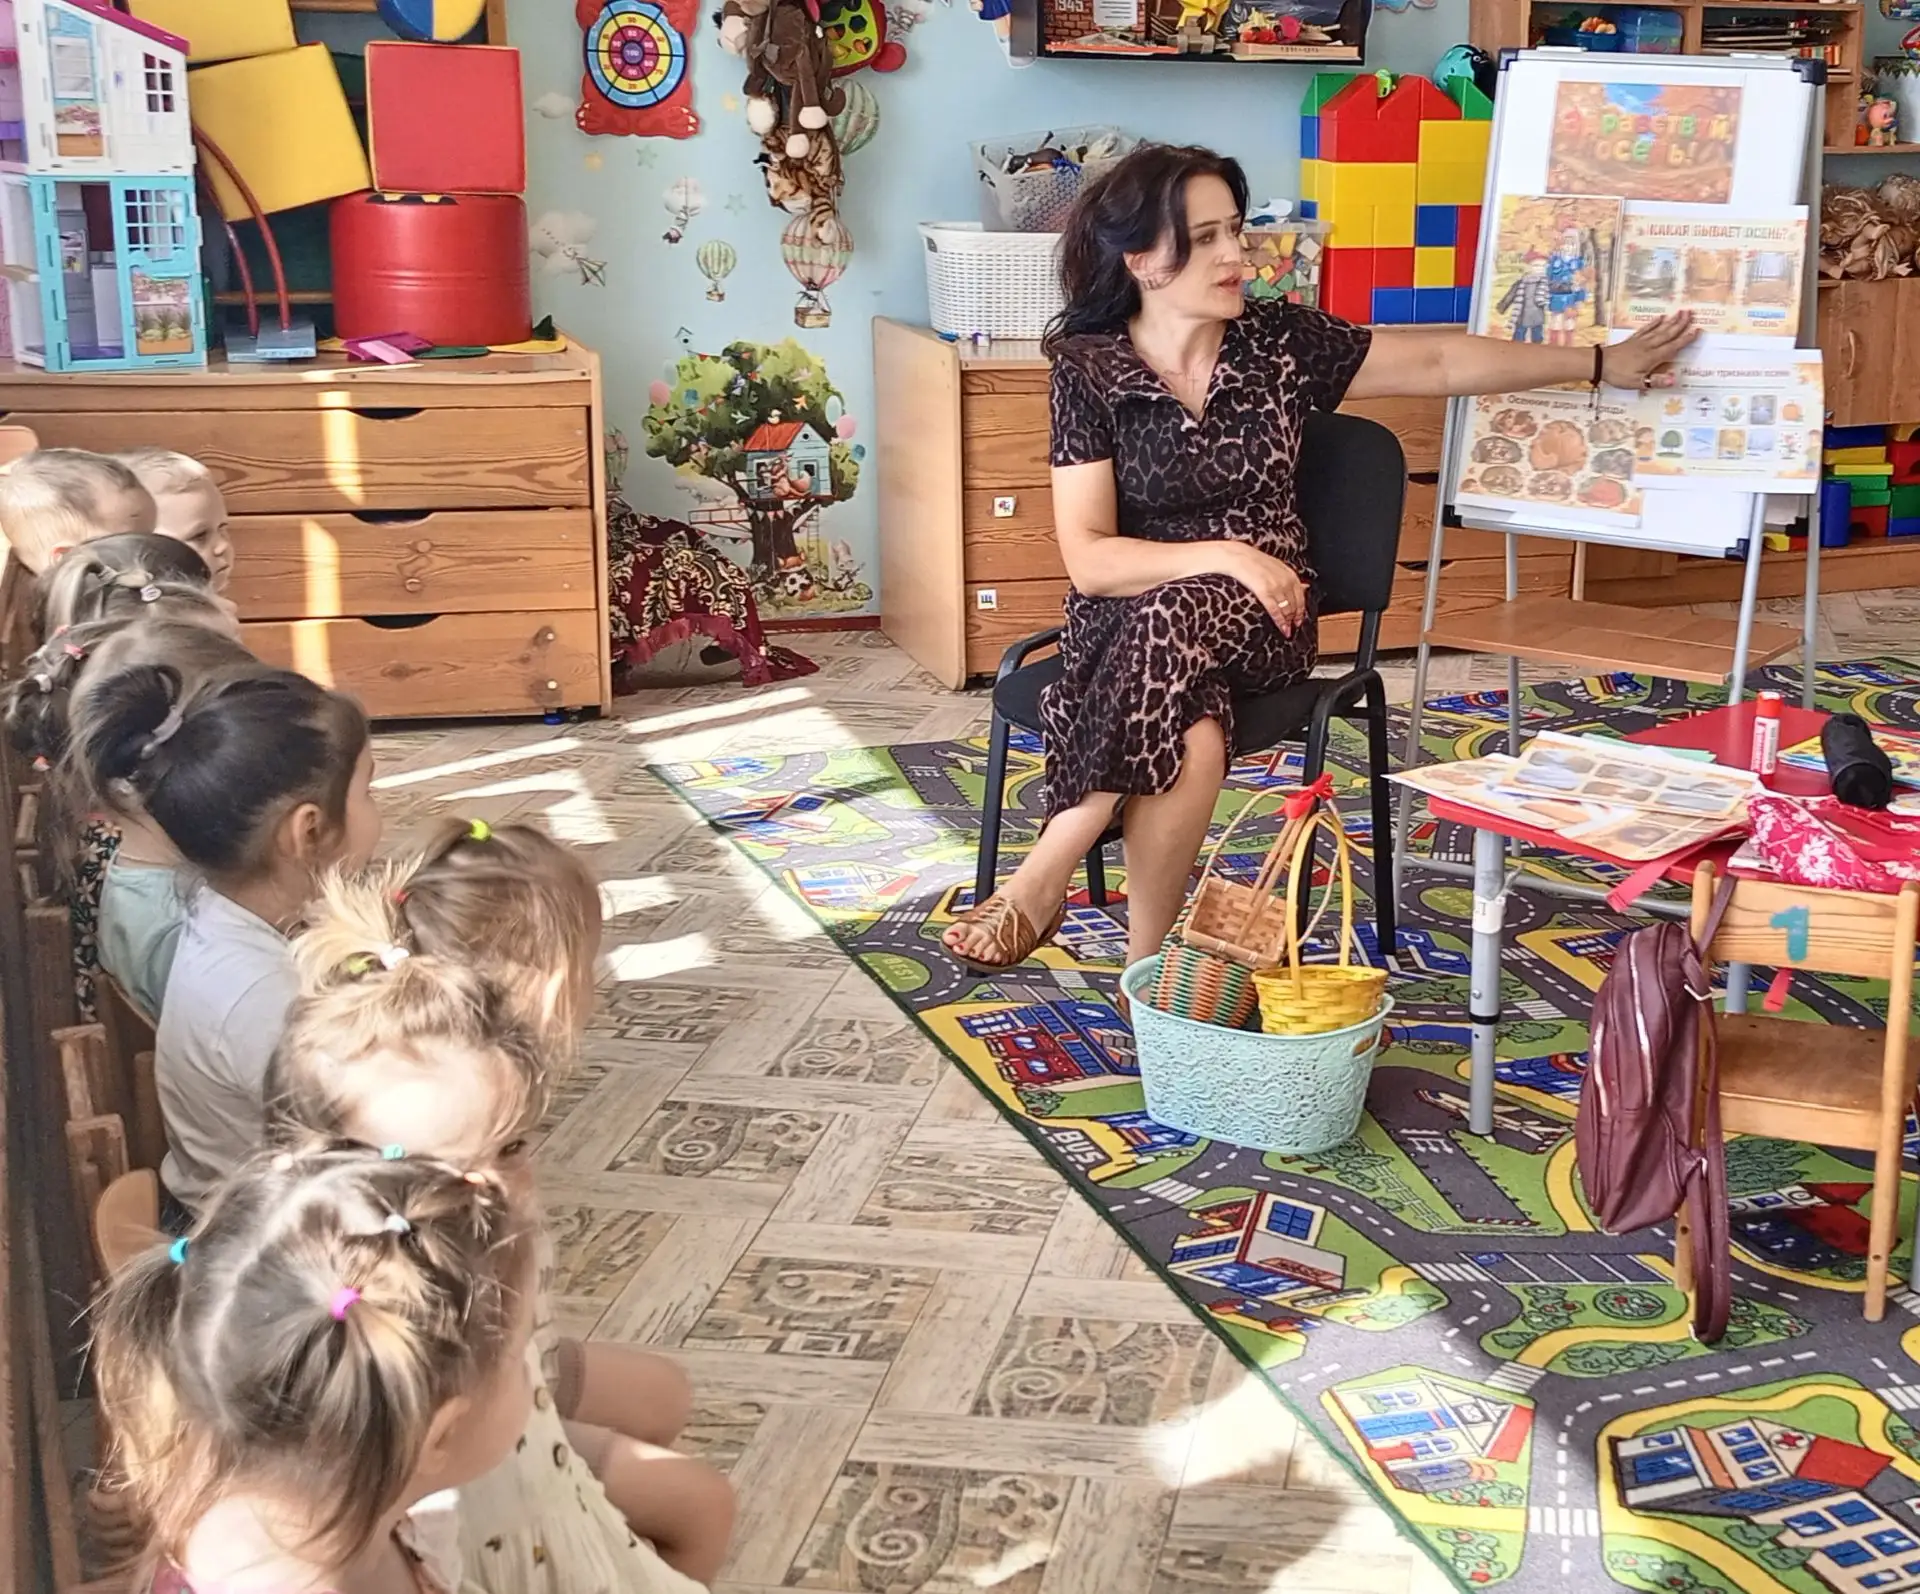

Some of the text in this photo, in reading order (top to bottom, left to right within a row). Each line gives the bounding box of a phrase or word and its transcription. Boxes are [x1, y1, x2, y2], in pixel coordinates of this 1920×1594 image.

[1055, 0, 1084, 12] 1945
[1649, 223, 1788, 240] КАКАЯ БЫВАЕТ ОСЕНЬ?
[1771, 906, 1808, 963] 1
[1053, 1130, 1106, 1164] BUS
